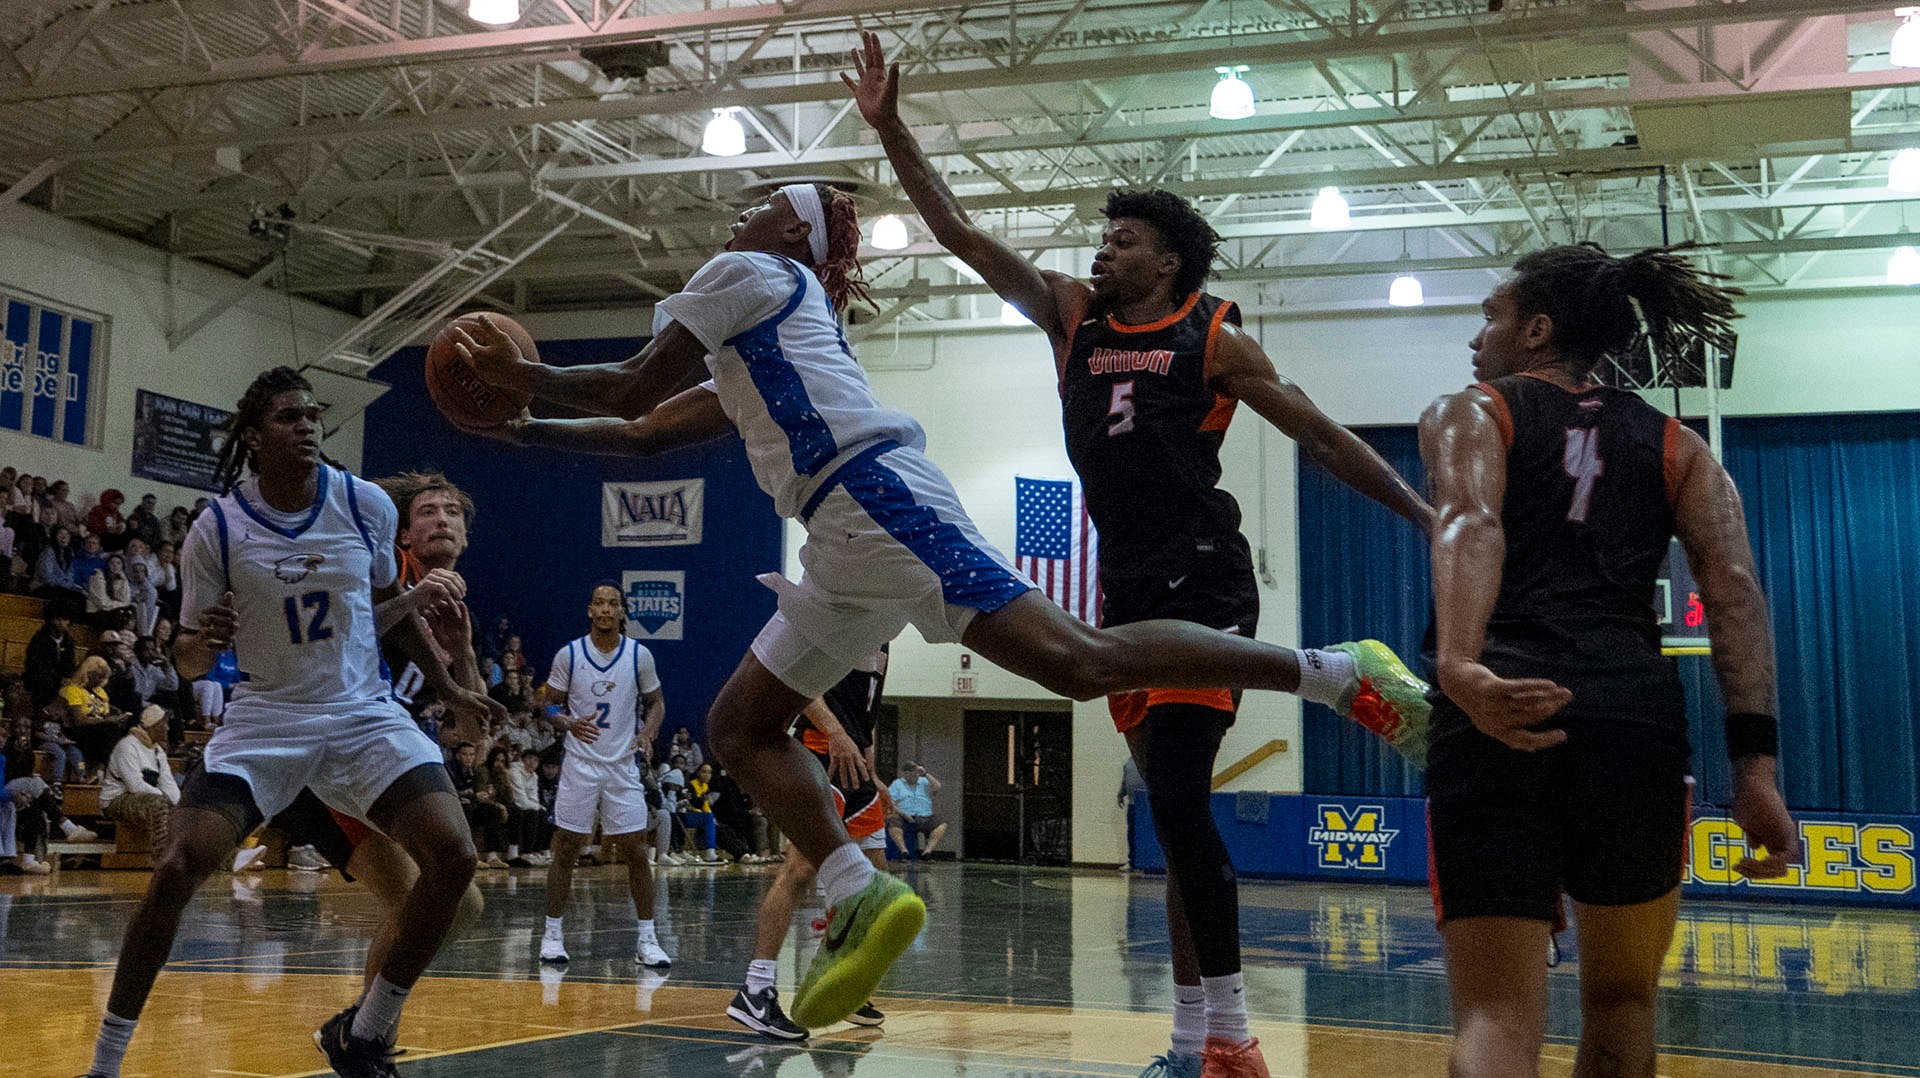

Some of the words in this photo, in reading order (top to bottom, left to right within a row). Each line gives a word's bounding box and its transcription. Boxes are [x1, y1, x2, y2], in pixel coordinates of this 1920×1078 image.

[1087, 347, 1175, 376] UNION
[1107, 380, 1136, 437] 5
[1562, 426, 1604, 522] 4
[616, 485, 689, 529] NAIA
[284, 590, 334, 645] 12
[626, 596, 680, 615] STATES
[957, 677, 974, 691] EXIT
[595, 702, 611, 729] 2
[1313, 830, 1391, 843] MIDWAY
[1683, 817, 1916, 893] GLES
